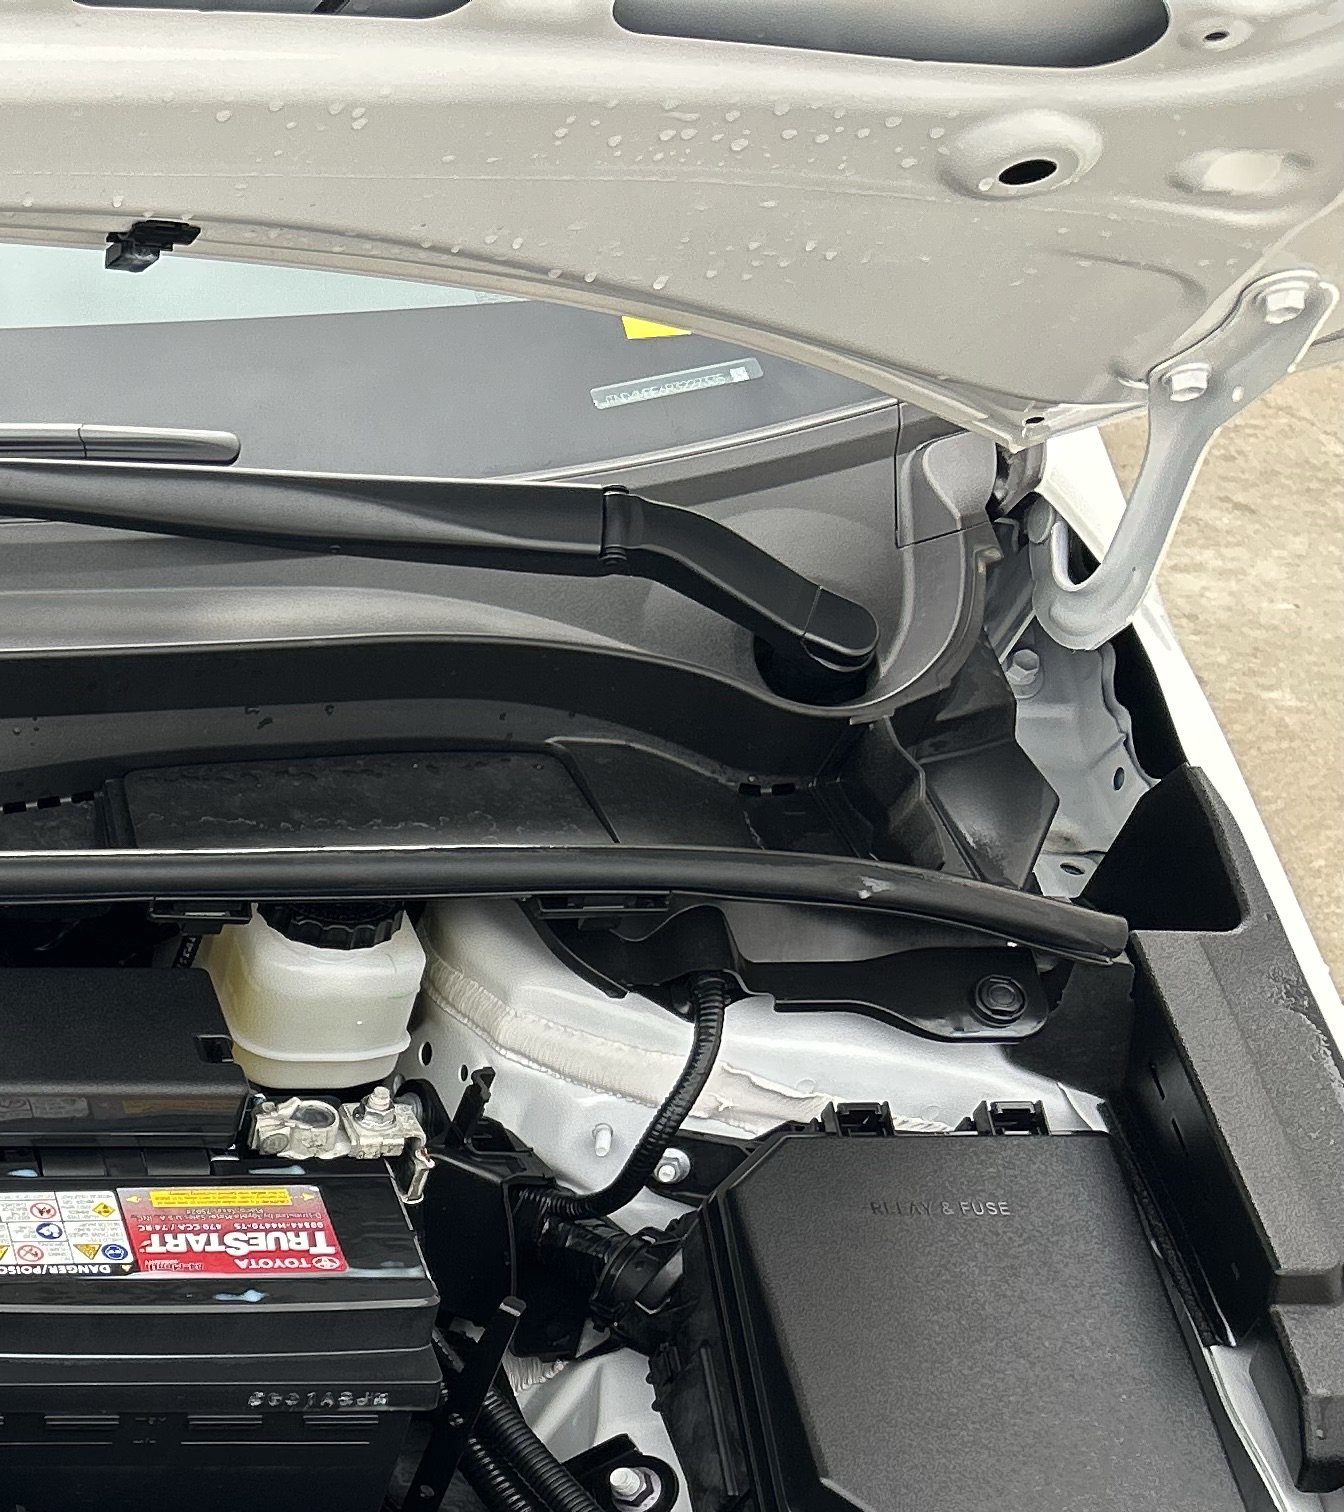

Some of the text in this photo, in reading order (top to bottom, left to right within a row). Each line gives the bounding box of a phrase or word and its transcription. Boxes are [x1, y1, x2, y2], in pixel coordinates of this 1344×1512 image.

[942, 1201, 955, 1216] &
[959, 1201, 1011, 1216] FUSE
[234, 1258, 311, 1270] TOYOTA
